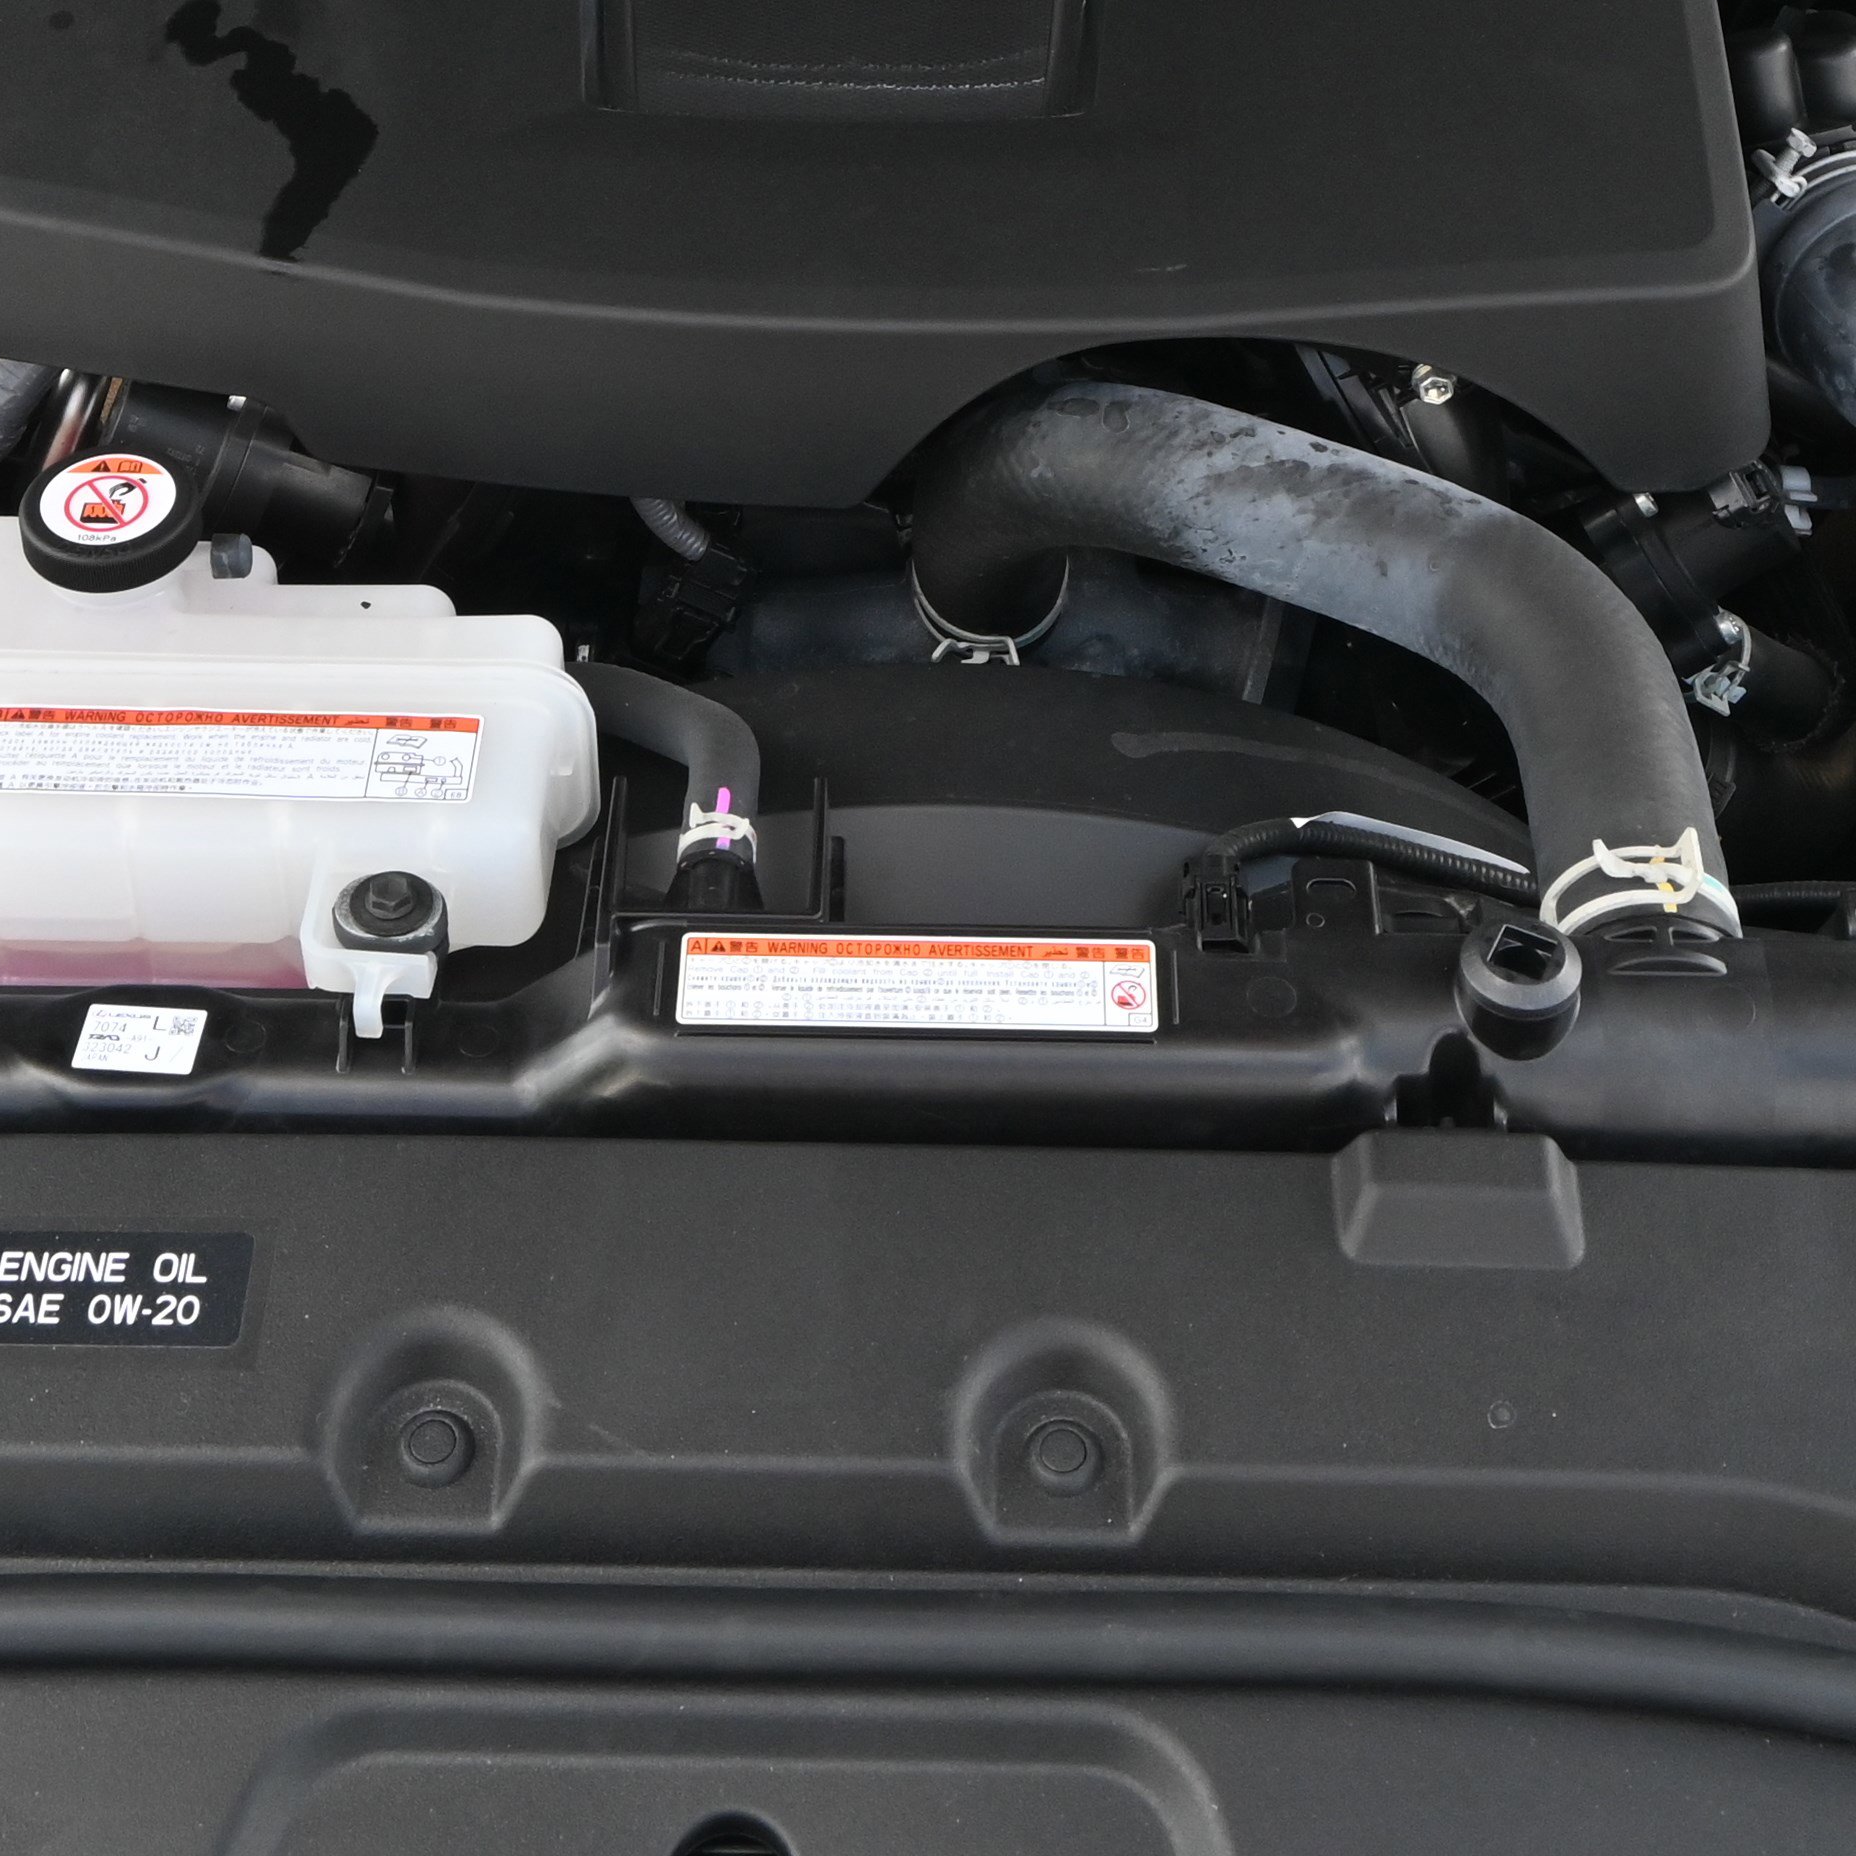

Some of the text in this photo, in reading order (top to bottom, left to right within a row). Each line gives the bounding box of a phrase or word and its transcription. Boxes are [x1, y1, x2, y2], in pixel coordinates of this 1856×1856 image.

[77, 534, 117, 543] 108kPa
[64, 710, 126, 722] WARNING
[232, 713, 341, 726] AVERTISSEMENT
[767, 942, 829, 954] WARNING
[929, 944, 1034, 958] AVERTISSEMENT
[93, 1020, 128, 1033] 7074
[152, 1015, 167, 1032] L
[144, 1046, 161, 1062] J
[152, 1252, 208, 1284] OIL
[87, 1294, 201, 1327] 0W-20
